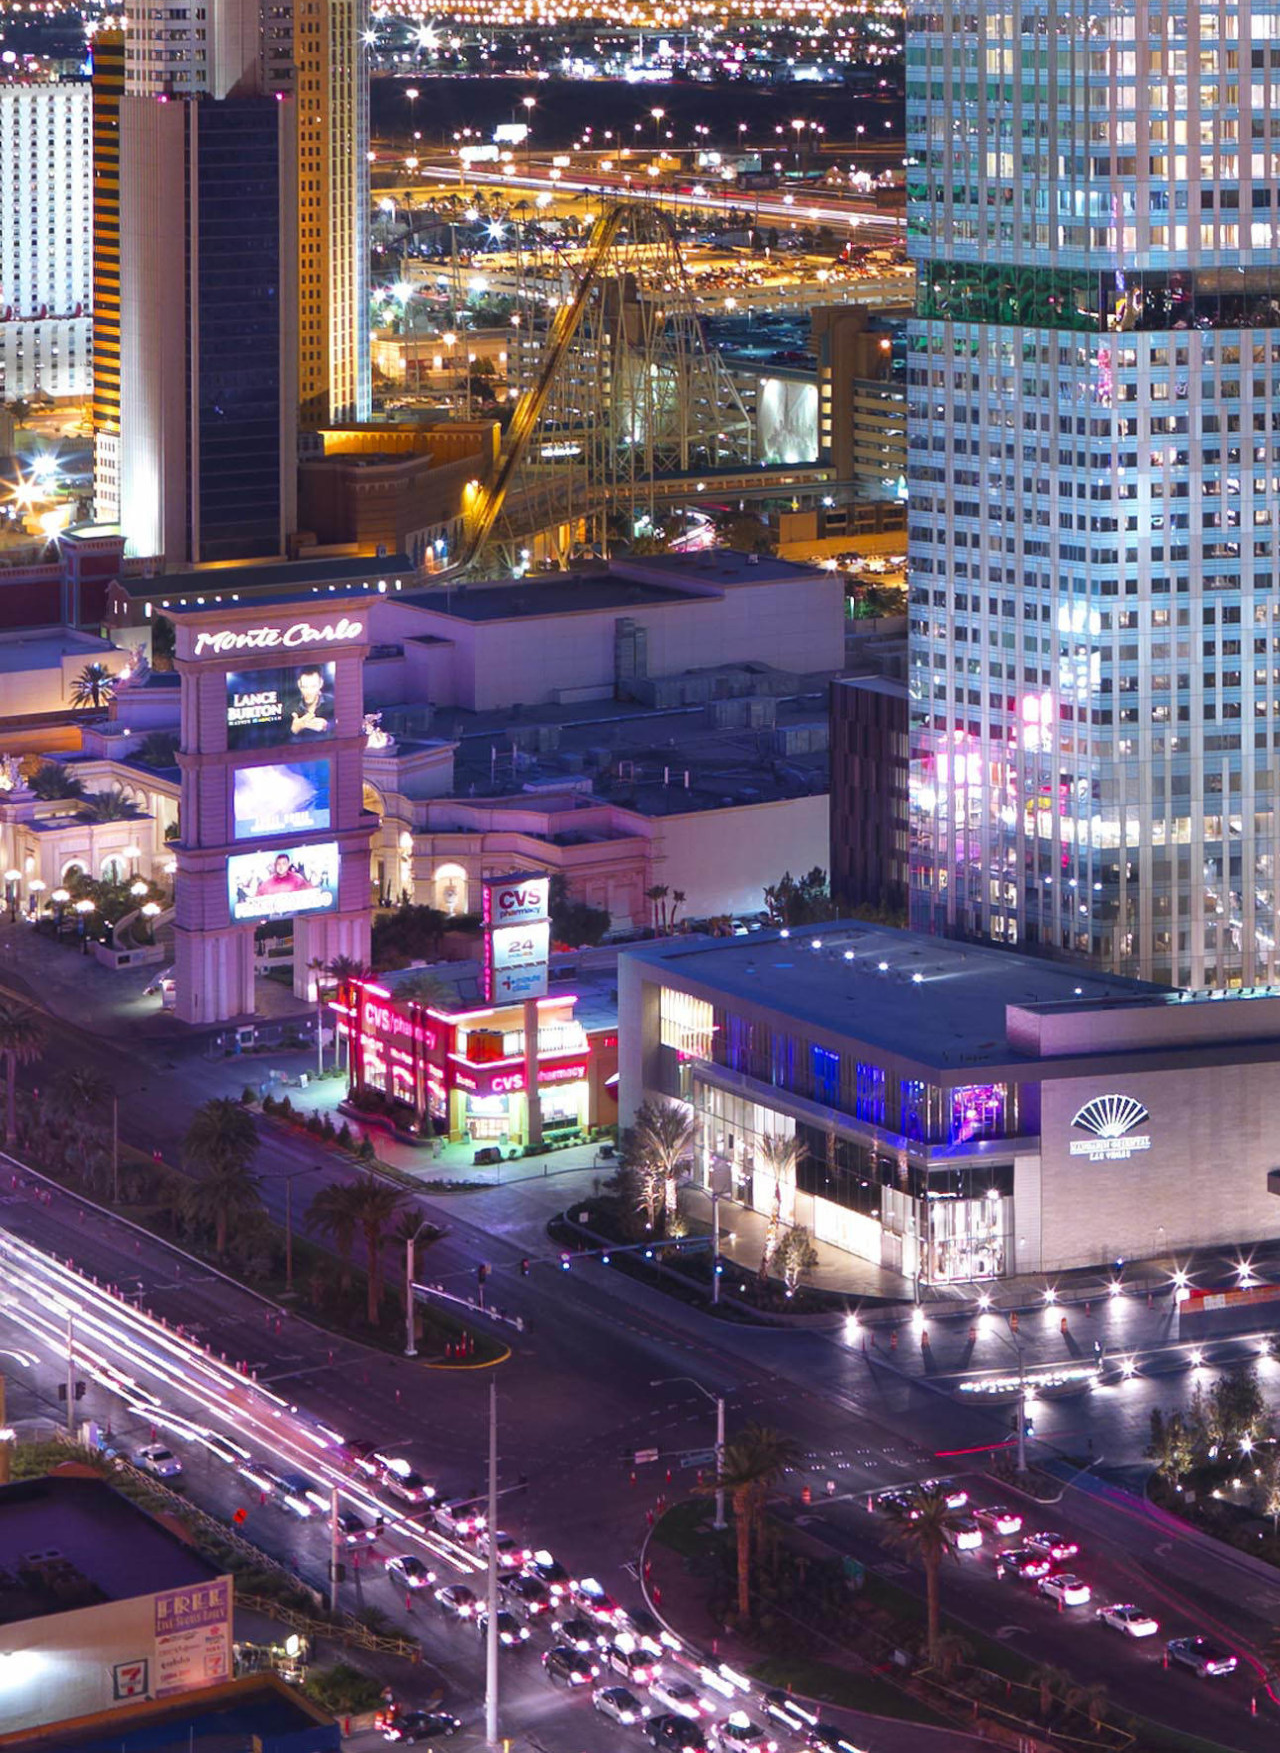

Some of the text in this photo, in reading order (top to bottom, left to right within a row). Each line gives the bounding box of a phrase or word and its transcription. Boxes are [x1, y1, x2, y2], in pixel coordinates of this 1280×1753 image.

[194, 618, 363, 655] Monte Carlo
[234, 691, 277, 707] LANCE
[227, 703, 283, 721] BURTON
[499, 889, 541, 909] CVS
[500, 907, 541, 919] pharmacy
[508, 939, 534, 953] 24
[492, 1073, 523, 1092] CVS
[536, 1065, 586, 1082] harmacy
[157, 1587, 225, 1618] FREE
